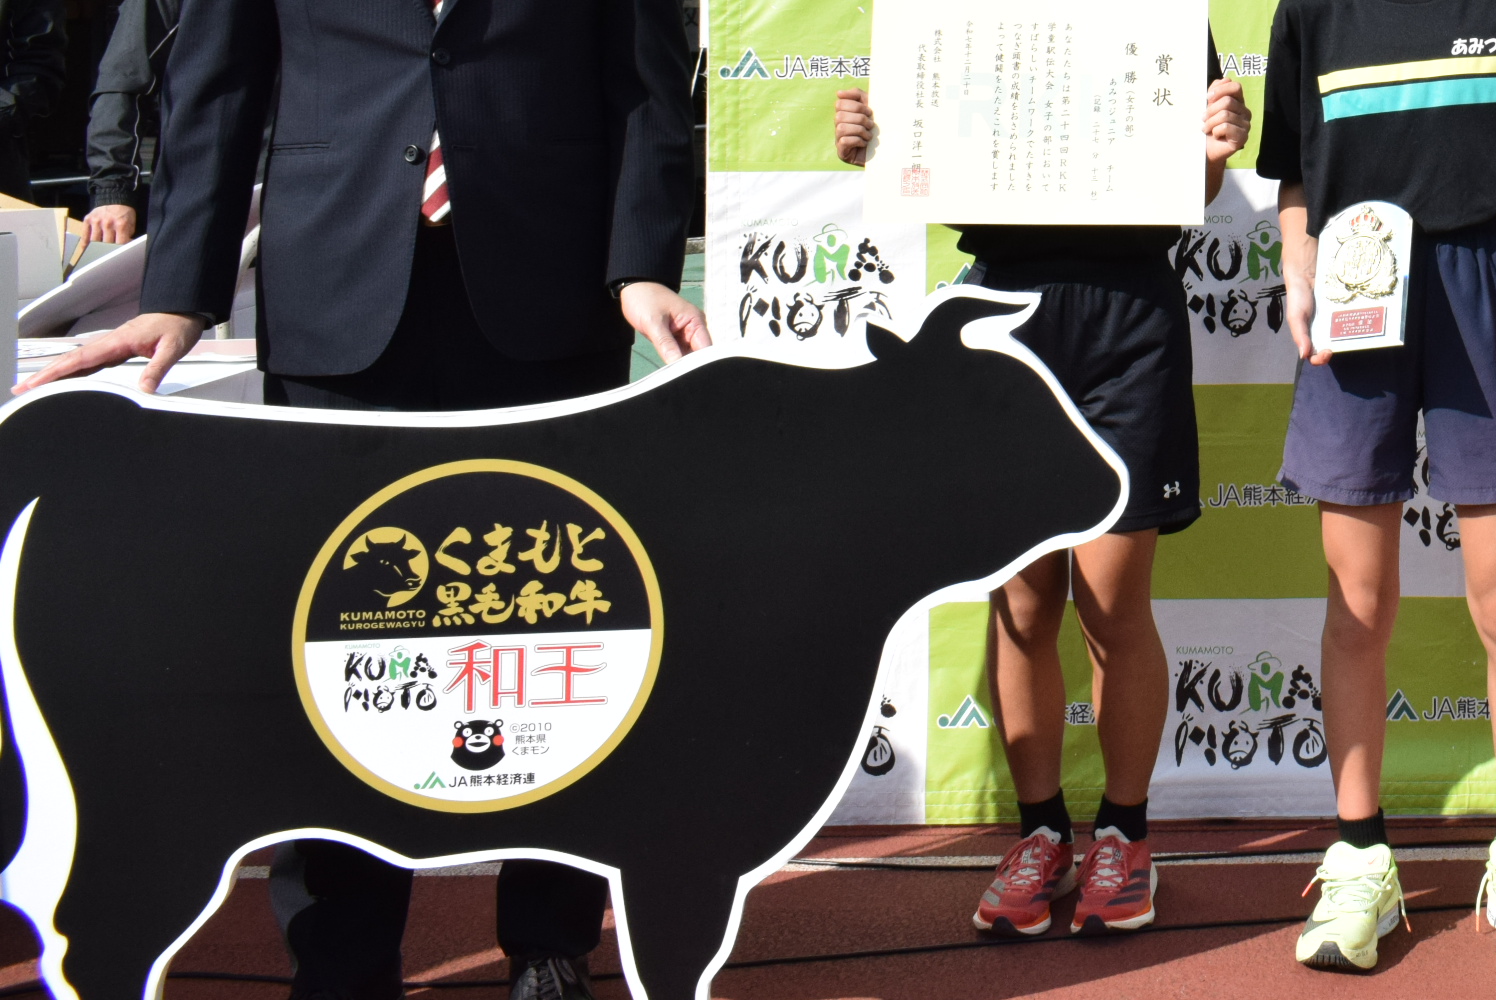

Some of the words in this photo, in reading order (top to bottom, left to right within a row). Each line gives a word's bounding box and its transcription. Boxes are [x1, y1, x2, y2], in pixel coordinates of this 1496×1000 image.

[775, 56, 870, 78] JA熊本経
[1153, 54, 1174, 107] 賞状
[740, 223, 895, 285] KUMA
[1177, 219, 1284, 284] KUM
[434, 519, 606, 575] くまもと
[340, 610, 426, 621] KUMAMOTO
[432, 580, 612, 627] 黒毛和牛
[340, 620, 426, 631] KUROGEWAGYU
[344, 646, 437, 682] KUMA
[443, 640, 608, 713] 和王
[344, 681, 437, 713] MOTO
[509, 722, 552, 733] ©2010
[515, 733, 546, 744] 熊本県
[1175, 714, 1328, 769] MOTO
[511, 745, 550, 756] くまモン
[449, 773, 536, 787] JA熊本経済連
